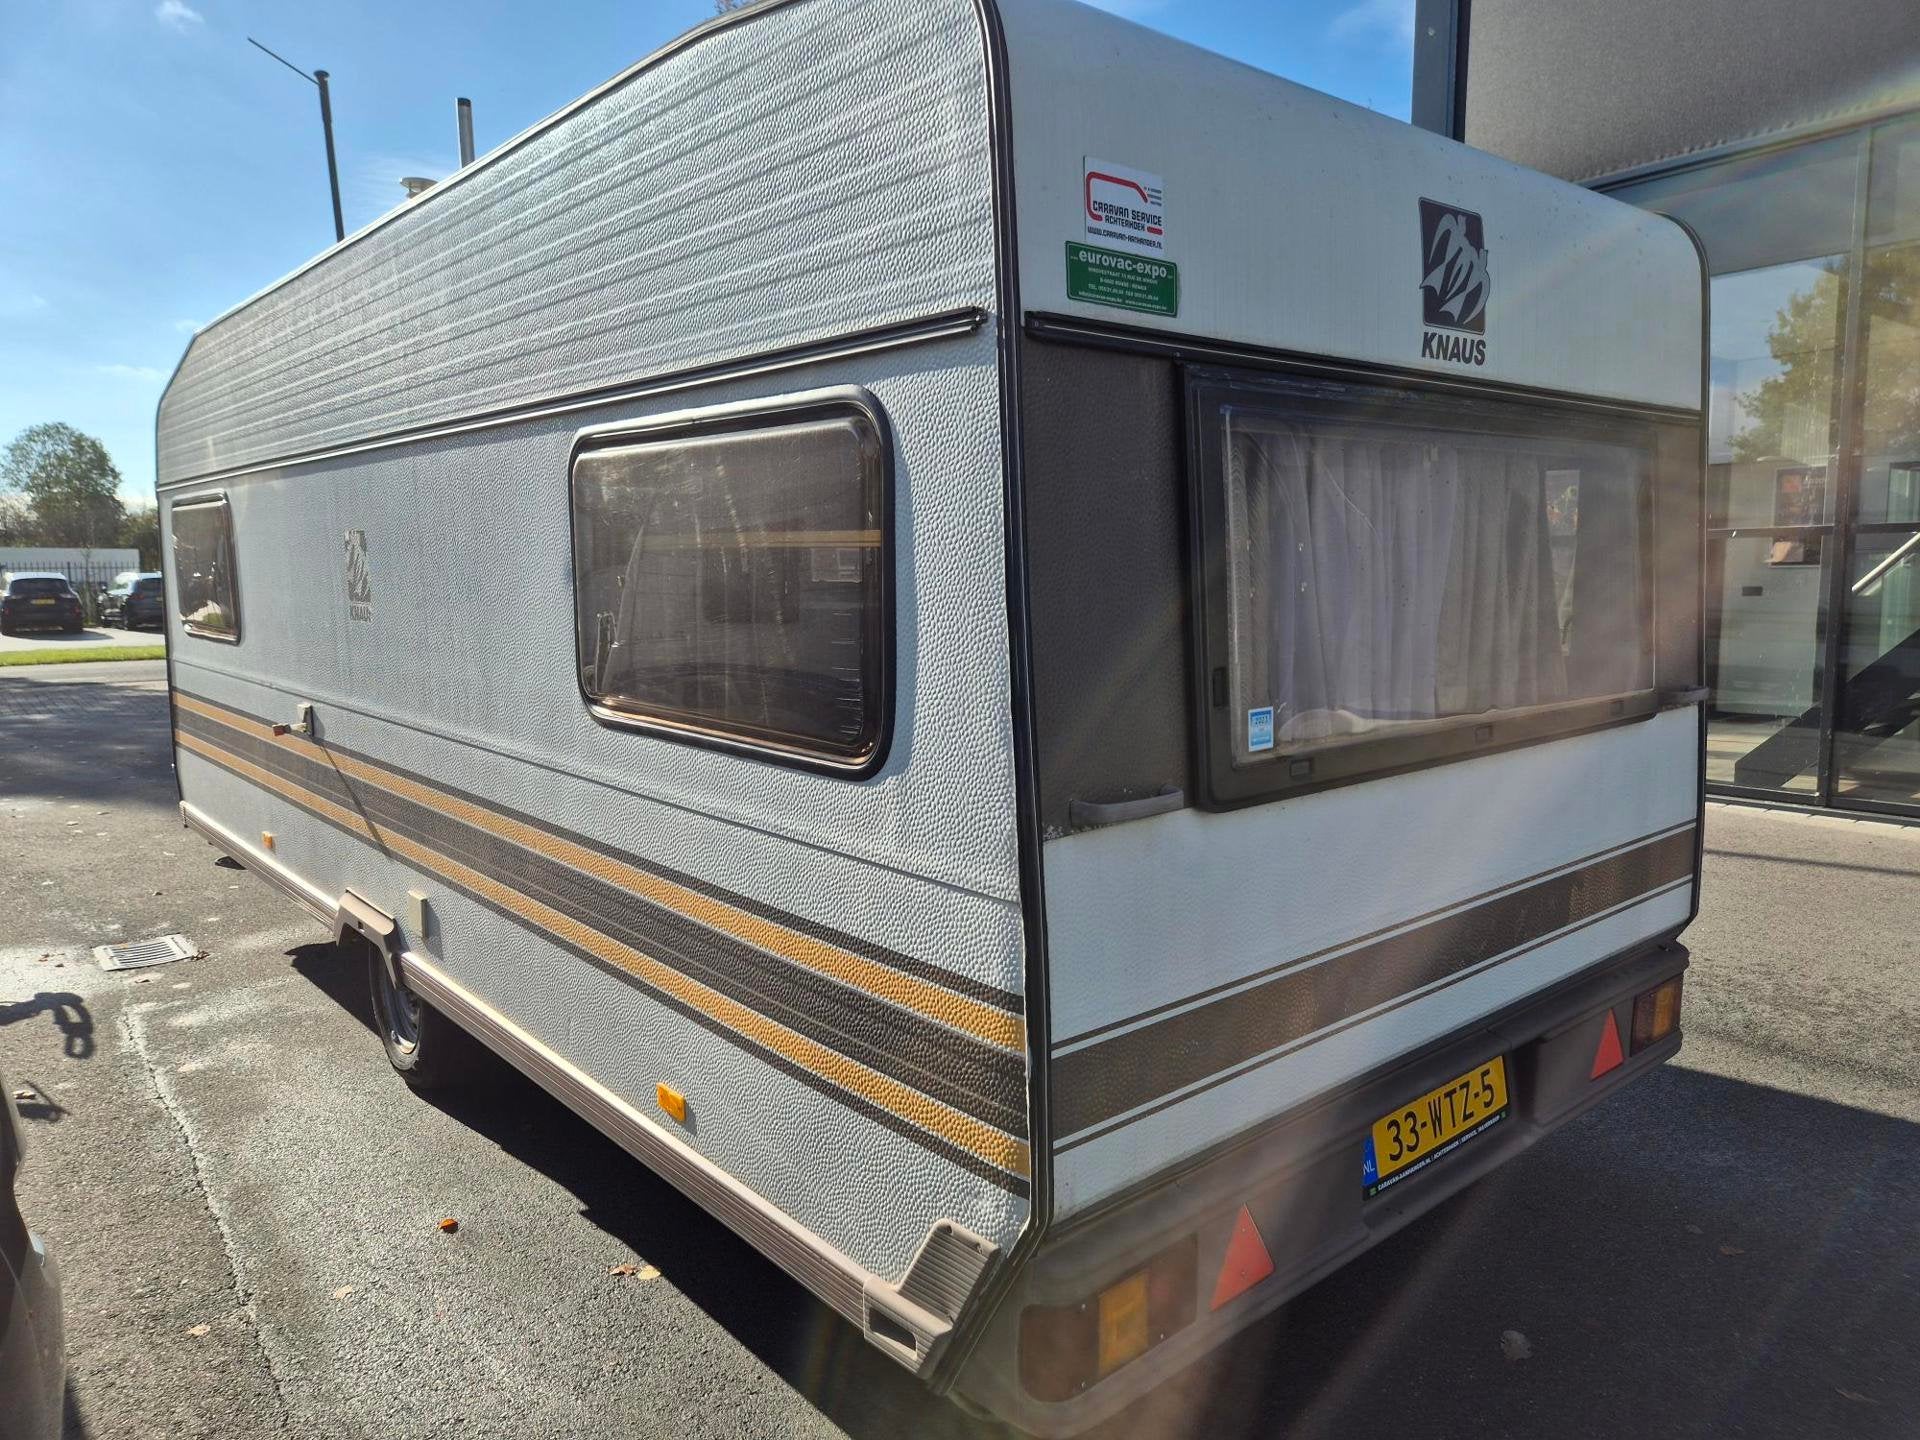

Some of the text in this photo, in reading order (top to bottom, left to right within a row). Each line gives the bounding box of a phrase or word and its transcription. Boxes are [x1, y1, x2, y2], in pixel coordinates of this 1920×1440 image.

[1092, 200, 1162, 227] CARAVAN SERVICE
[1105, 214, 1146, 231] ACHTERHOEK
[1078, 250, 1168, 279] eurovac-expo
[1421, 331, 1487, 367] KNAUS
[1386, 1068, 1496, 1162] 33-WTZ-5
[1362, 1159, 1376, 1176] NL
